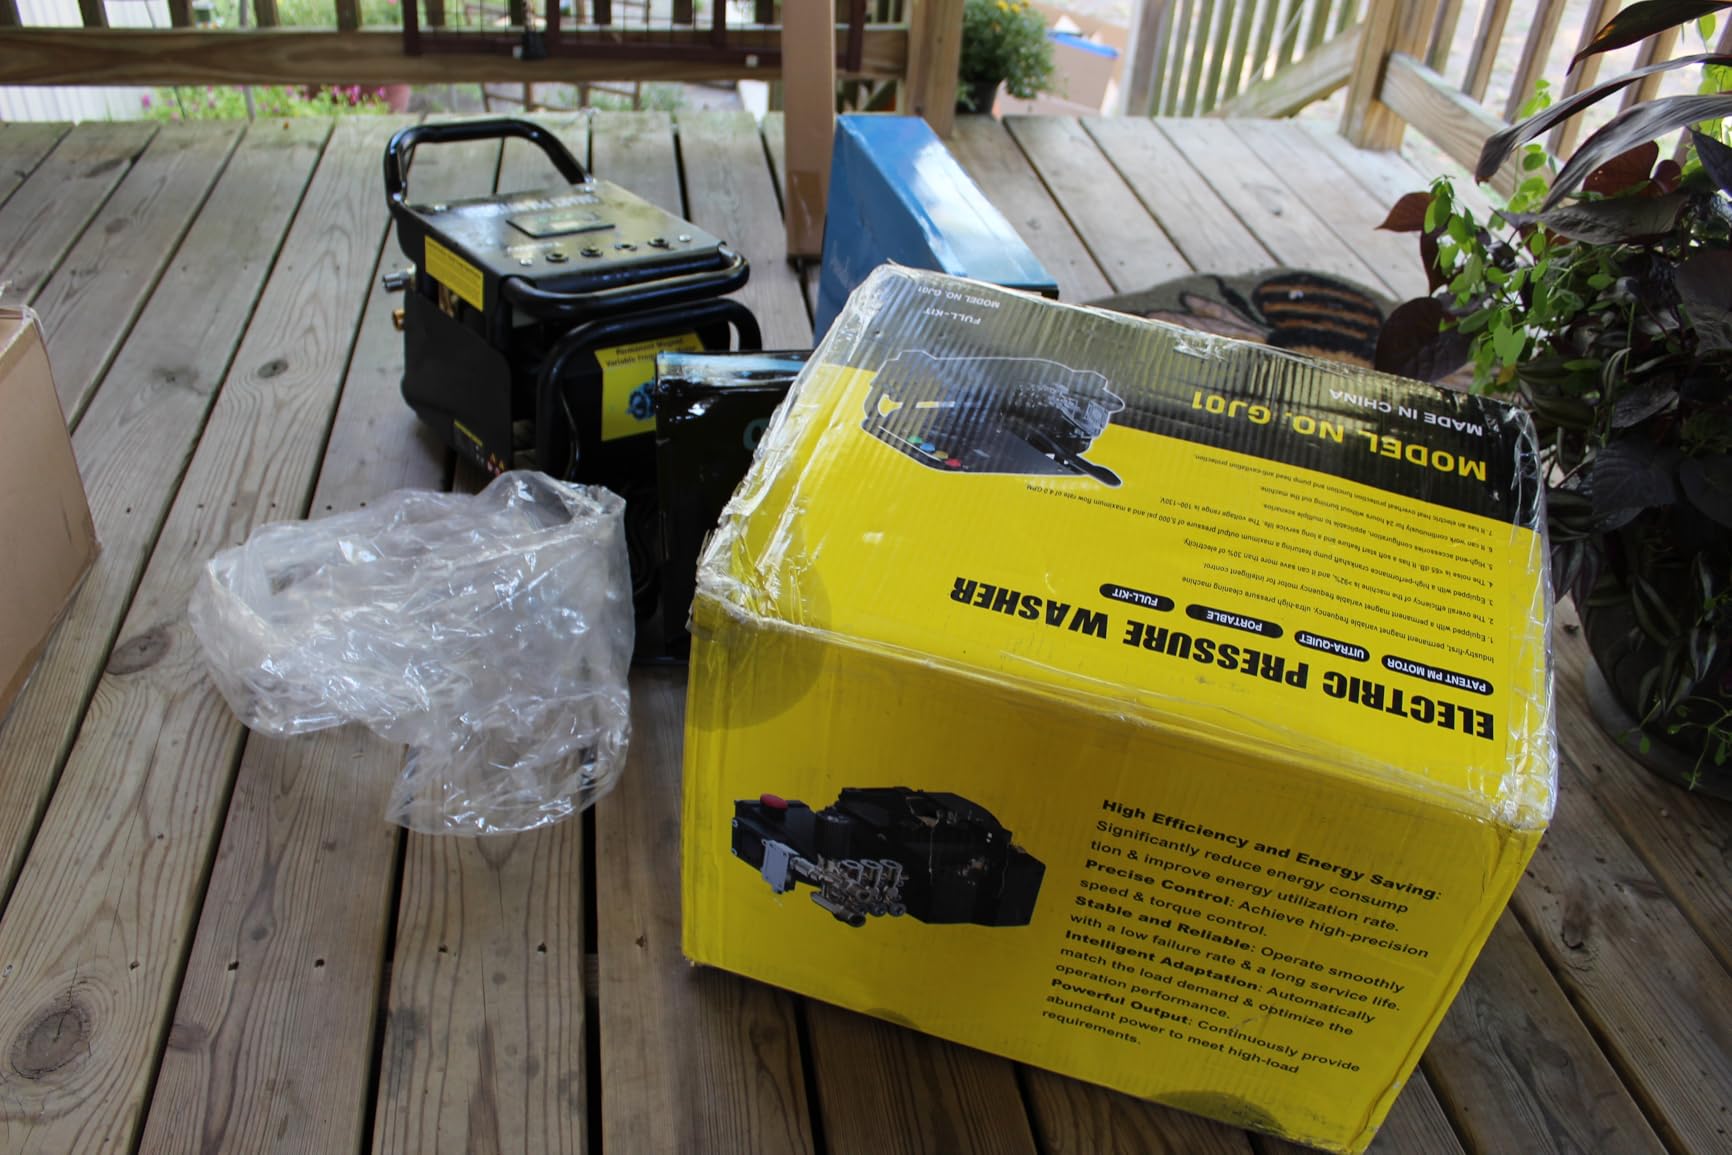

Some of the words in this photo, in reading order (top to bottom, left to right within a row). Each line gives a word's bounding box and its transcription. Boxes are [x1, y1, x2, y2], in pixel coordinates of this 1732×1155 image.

[917, 285, 941, 296] GJ01
[944, 290, 961, 301] NO.
[964, 294, 1000, 309] MODEL
[923, 308, 981, 325] FULL-KIT
[1191, 389, 1270, 425] GJ01
[1329, 388, 1391, 413] CHINA
[1398, 405, 1416, 419] IN
[1285, 411, 1343, 442] NO.
[1423, 411, 1482, 436] MADE
[1358, 428, 1486, 481] MODEL
[1181, 576, 1212, 588] machine
[1229, 568, 1265, 582] intelligent
[1265, 577, 1276, 585] for
[1276, 579, 1299, 590] motor
[1111, 587, 1157, 606] FULL-KIT
[1212, 582, 1243, 596] cleaning
[1244, 591, 1276, 603] pressure
[1299, 583, 1335, 600] frequency
[949, 575, 1108, 639] WASHER
[1277, 598, 1311, 612] ultra-high
[1335, 594, 1363, 607] variable
[1364, 602, 1390, 615] magnet
[1206, 609, 1262, 632] PORTABLE
[1312, 607, 1349, 625] frequency,
[1350, 618, 1378, 631] variable
[1391, 610, 1429, 626] permanent
[1379, 626, 1406, 639] magnet
[1435, 623, 1451, 631] with
[1452, 627, 1486, 642] Equipped
[1406, 634, 1445, 650] permanent
[1123, 618, 1307, 690] PRESSURE
[1446, 644, 1494, 664] Industry-first,
[1387, 657, 1424, 676] MOTOR
[1426, 668, 1443, 680] PM
[1444, 672, 1485, 691] PATENT
[1321, 668, 1494, 739] ELECTRIC
[1102, 799, 1146, 820] High
[1151, 812, 1249, 848] Efficiency
[1253, 842, 1291, 858] and
[1295, 852, 1365, 881] Energy
[1369, 874, 1441, 900] Saving:
[1096, 820, 1200, 857] Significantly
[1204, 850, 1262, 872] reduce
[1266, 868, 1325, 892] energy
[1329, 886, 1408, 914] consump
[1091, 840, 1122, 856] tion
[1126, 849, 1138, 861] &
[1144, 853, 1211, 879] improve
[1215, 875, 1273, 898] energy
[1277, 892, 1358, 921] utilization
[1362, 916, 1398, 931] rate.
[1079, 879, 1129, 898] speed
[1132, 891, 1144, 902] &
[1150, 896, 1201, 917] torque
[1206, 913, 1266, 936] control.
[1085, 858, 1155, 885] Precise
[1161, 879, 1234, 907] Control:
[1237, 901, 1304, 926] Achieve
[1309, 919, 1428, 958] high-precision
[1075, 895, 1132, 918] Stable
[1138, 914, 1172, 928] and
[1176, 922, 1255, 952] Reliable:
[1260, 946, 1324, 971] Operate
[1328, 967, 1405, 994] smoothly
[1070, 914, 1102, 928] with
[1106, 924, 1116, 932] a
[1120, 926, 1148, 940] low
[1152, 934, 1201, 956] failure
[1205, 951, 1236, 965] rate
[1240, 960, 1251, 970] &
[1256, 966, 1266, 974] a
[1270, 968, 1306, 987] long
[1310, 981, 1368, 1002] service
[1372, 996, 1399, 1011] life.
[1065, 929, 1155, 962] Intelligent
[1159, 956, 1262, 992] Adaptation:
[1266, 987, 1376, 1024] Automatically
[1055, 964, 1127, 989] operation
[1130, 985, 1230, 1019] performance.
[1060, 948, 1106, 966] match
[1111, 960, 1135, 973] the
[1139, 967, 1173, 984] load
[1176, 980, 1239, 1003] demand
[1242, 997, 1253, 1007] &
[1258, 1003, 1324, 1027] optimize
[1328, 1022, 1353, 1035] the
[1042, 1011, 1140, 1044] requirements.
[1046, 995, 1116, 1020] abundant
[1118, 1015, 1165, 1034] power
[1169, 1029, 1183, 1039] to
[1187, 1035, 1224, 1052] meet
[1228, 1046, 1299, 1073] high-load
[1051, 978, 1125, 1005] Powerful
[1130, 1000, 1192, 1025] Output:
[1197, 1020, 1298, 1057] Continuously
[1301, 1052, 1360, 1072] provide
